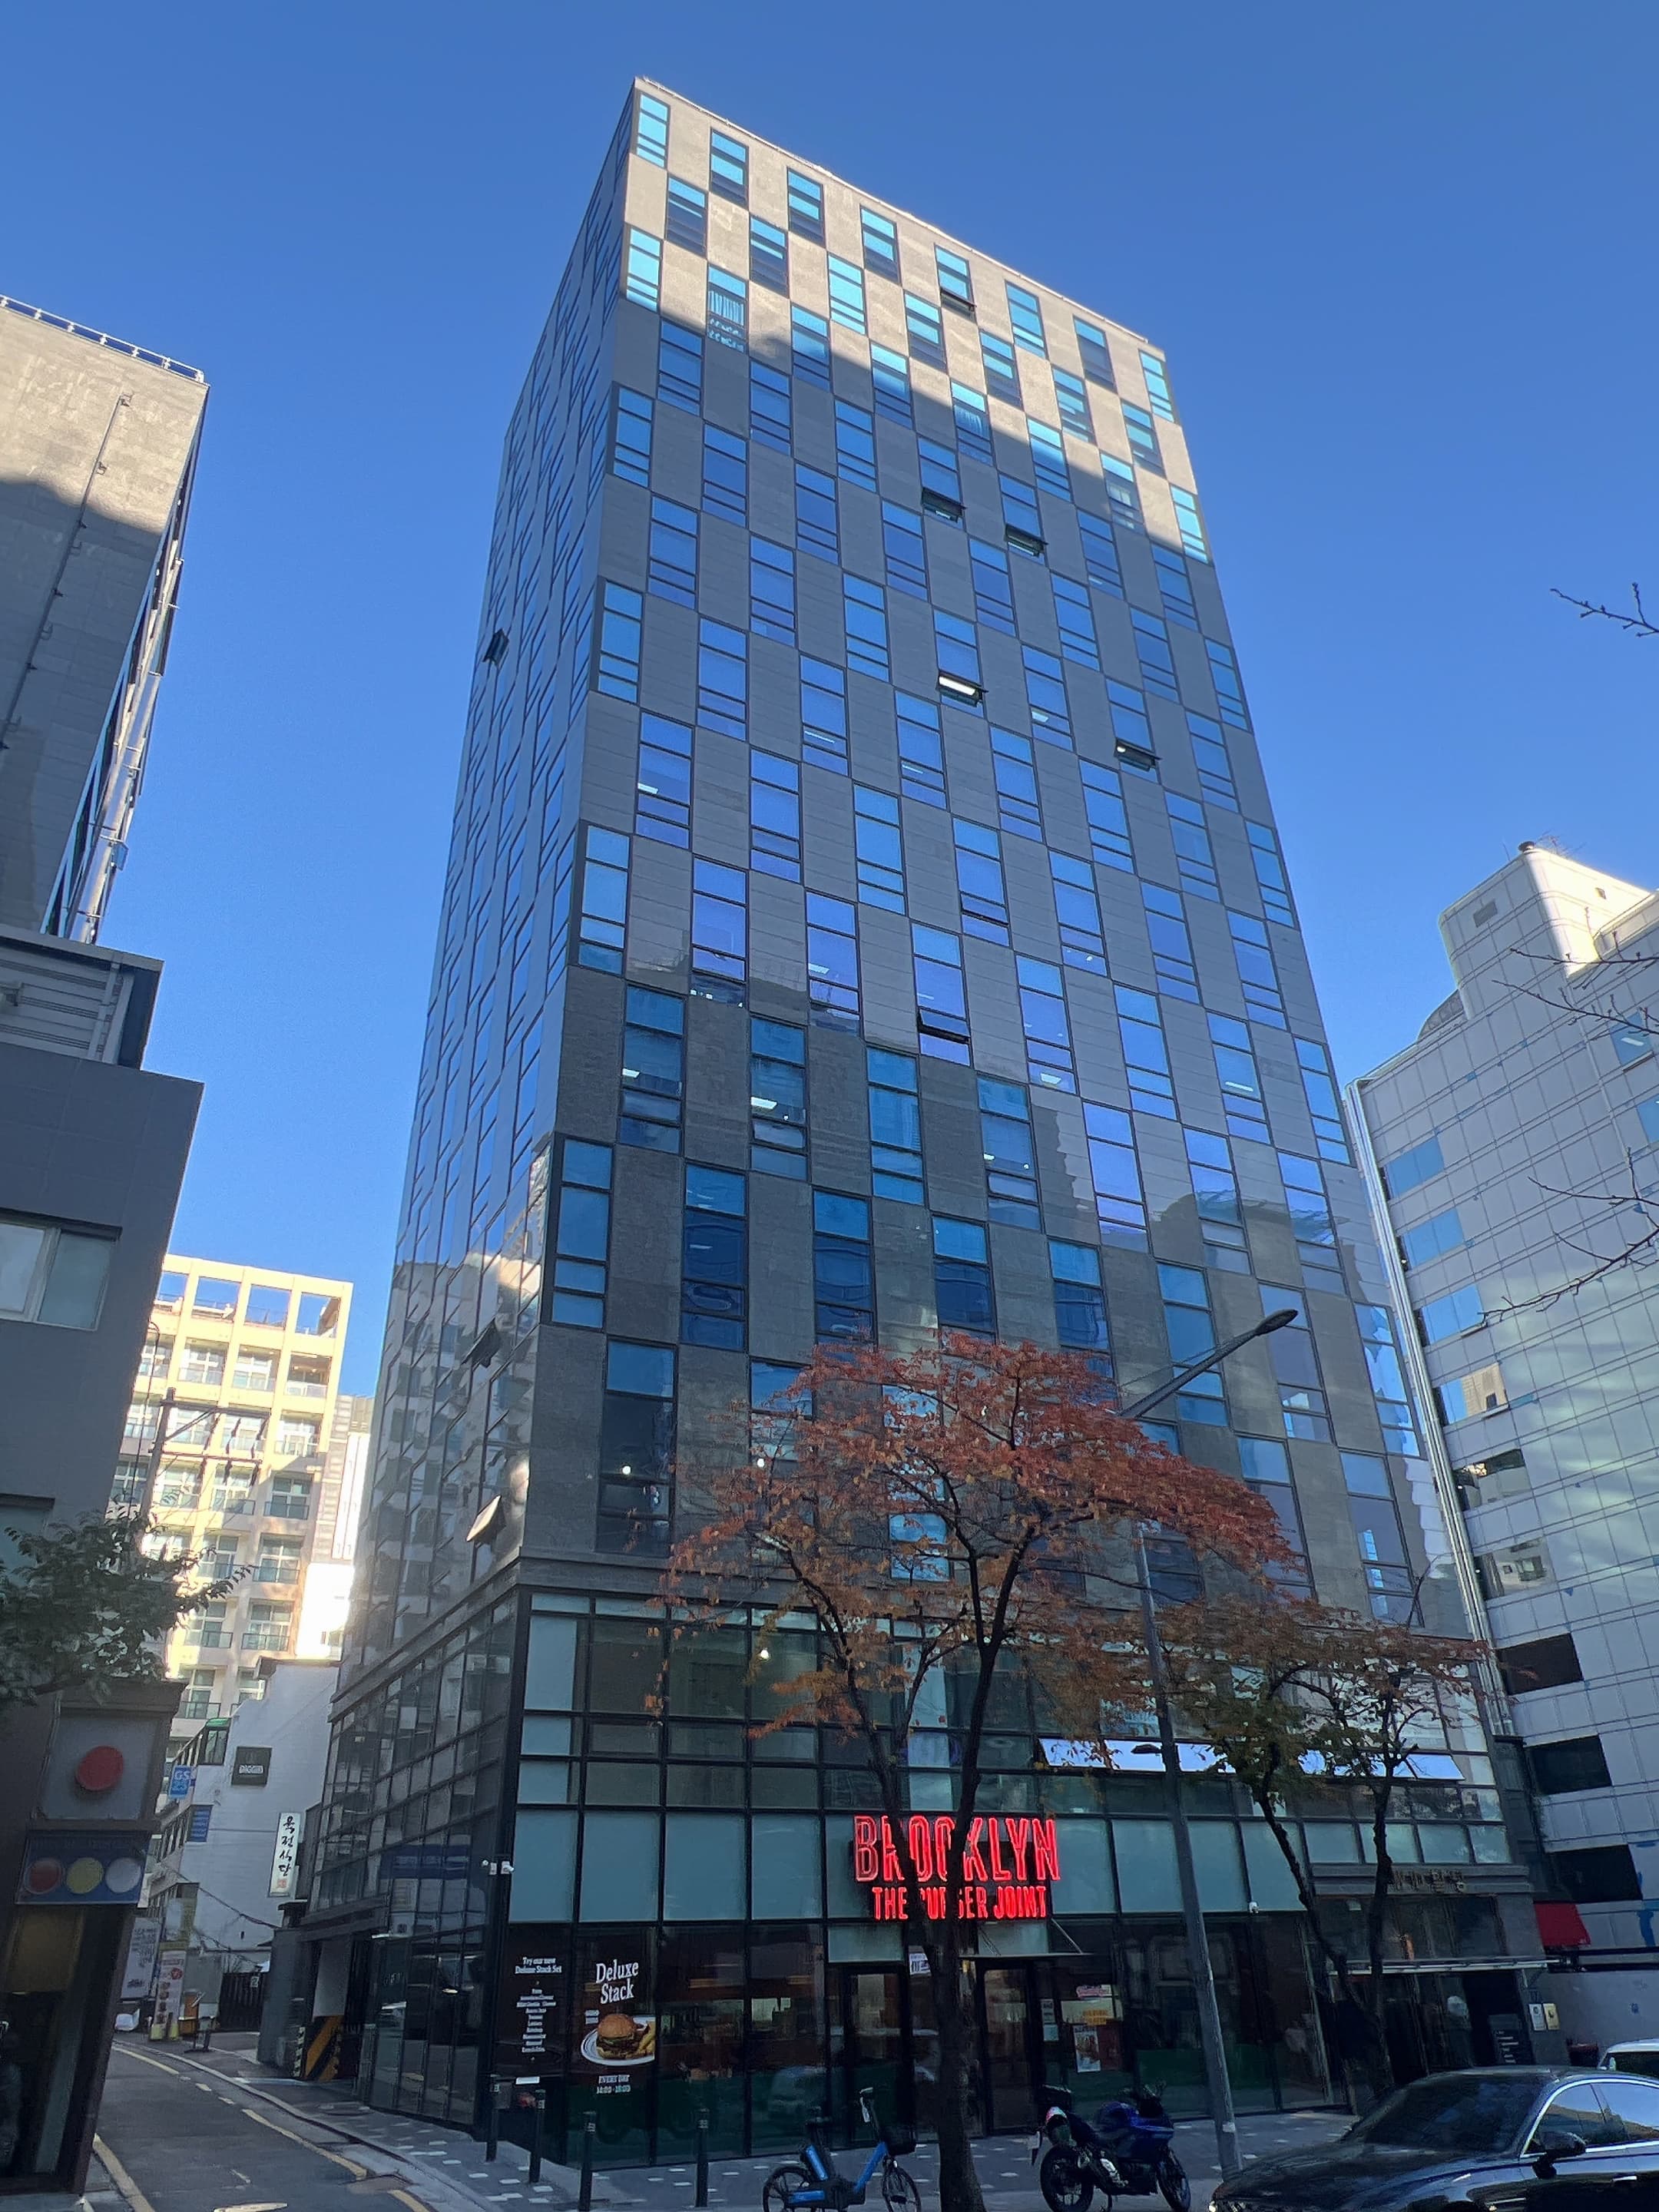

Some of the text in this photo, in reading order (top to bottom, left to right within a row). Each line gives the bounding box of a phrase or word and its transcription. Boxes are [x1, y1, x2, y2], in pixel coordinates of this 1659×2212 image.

[175, 1770, 191, 1780] GS
[872, 1886, 909, 1919] THE
[994, 1886, 1046, 1919] JOINT
[595, 1959, 640, 1984] Deluxe
[600, 1978, 634, 2005] Stack
